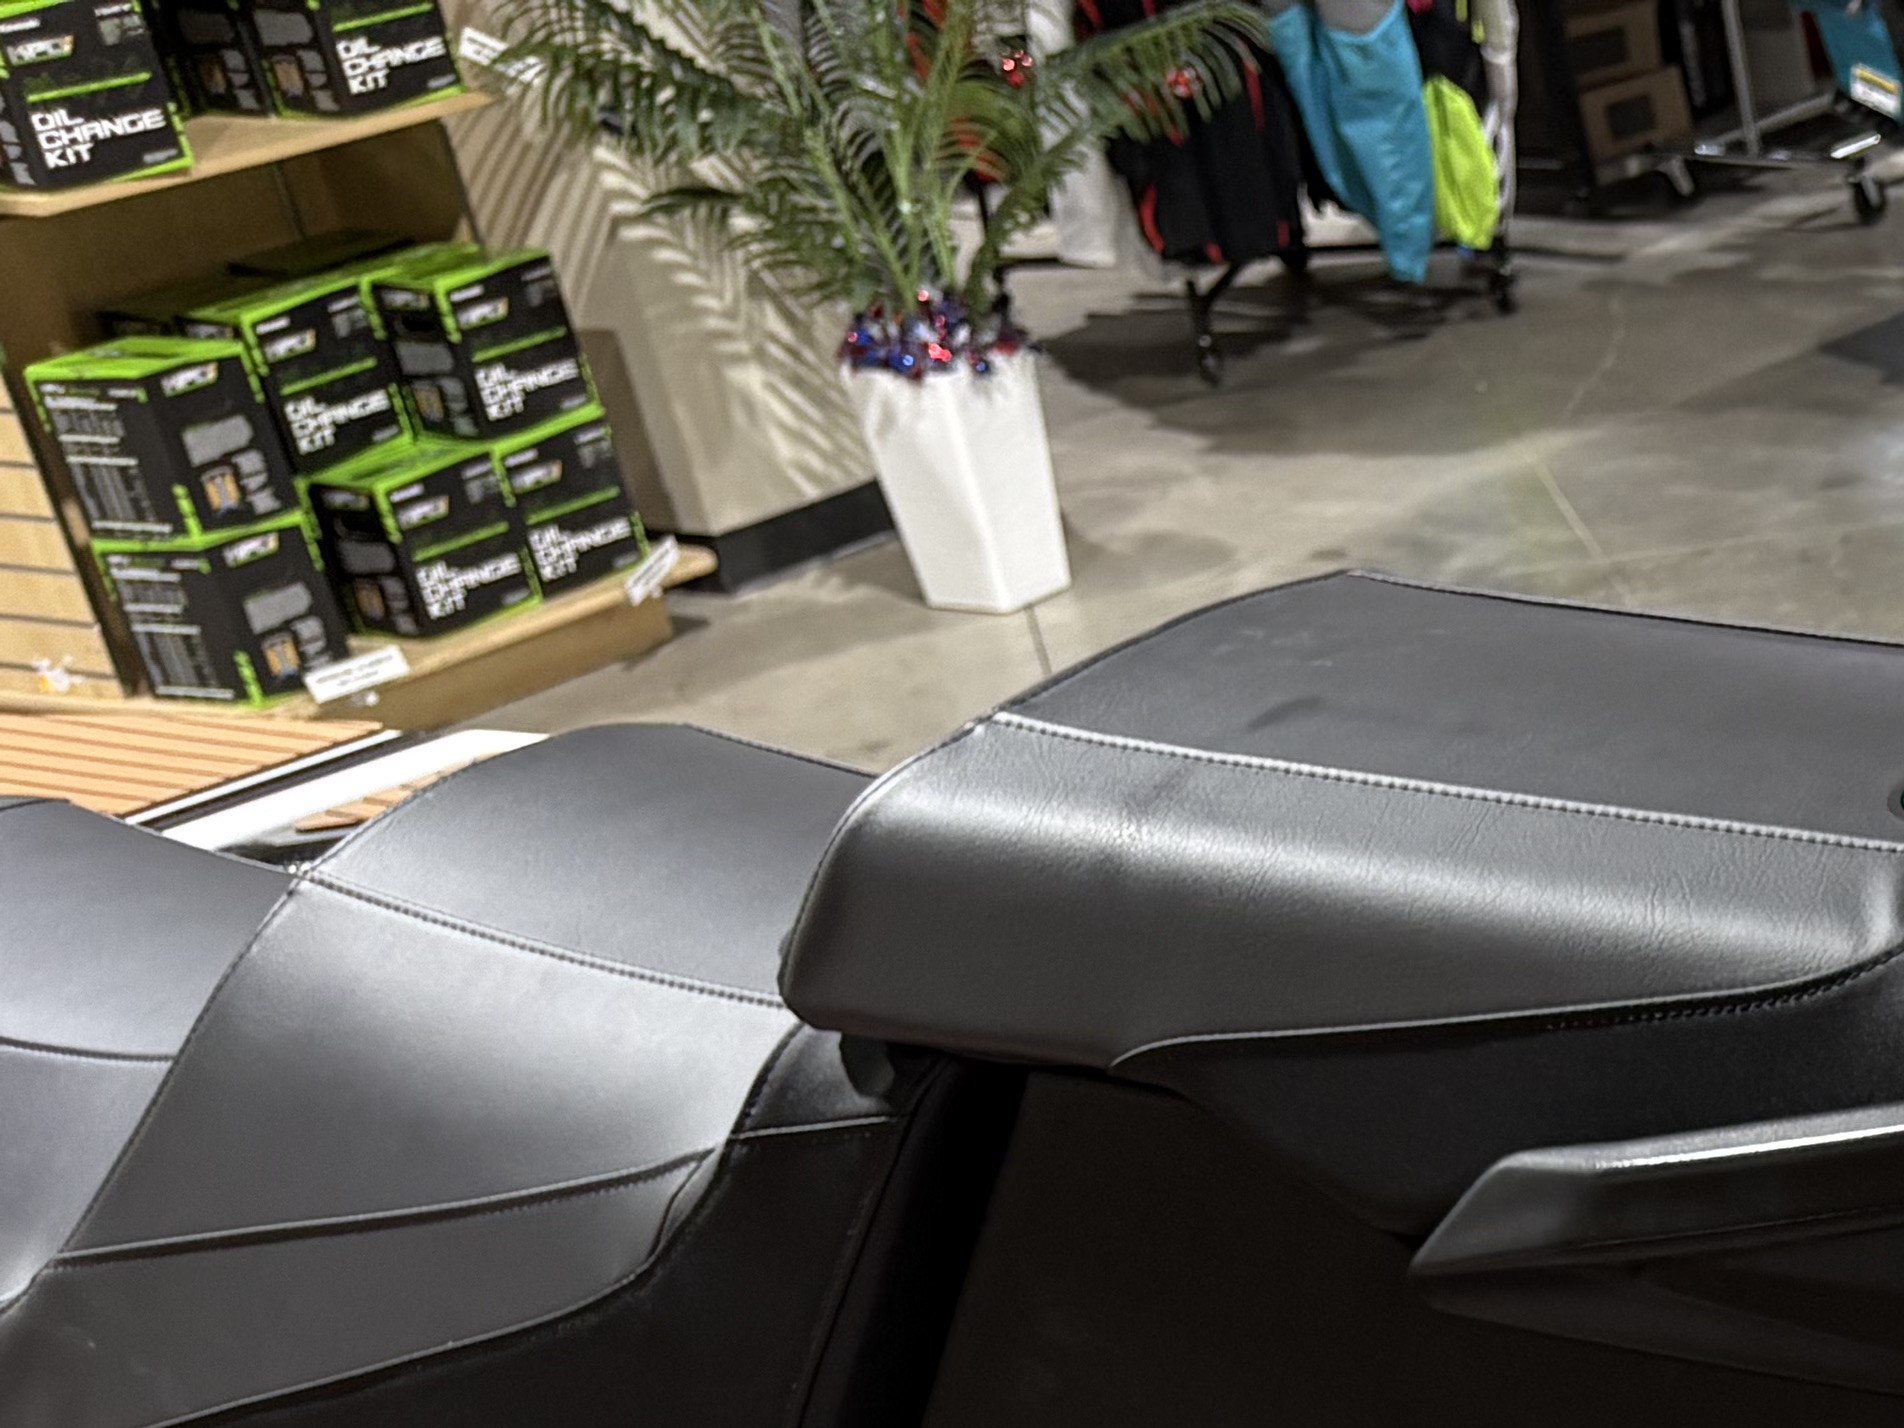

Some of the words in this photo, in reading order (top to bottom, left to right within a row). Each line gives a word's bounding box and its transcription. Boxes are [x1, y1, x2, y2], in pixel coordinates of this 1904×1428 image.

[336, 36, 381, 61] OIL
[342, 35, 446, 76] CHANGE
[348, 68, 390, 95] KIT
[31, 108, 84, 132] OIL
[37, 108, 167, 150] CHANGE
[44, 143, 95, 169] KIT
